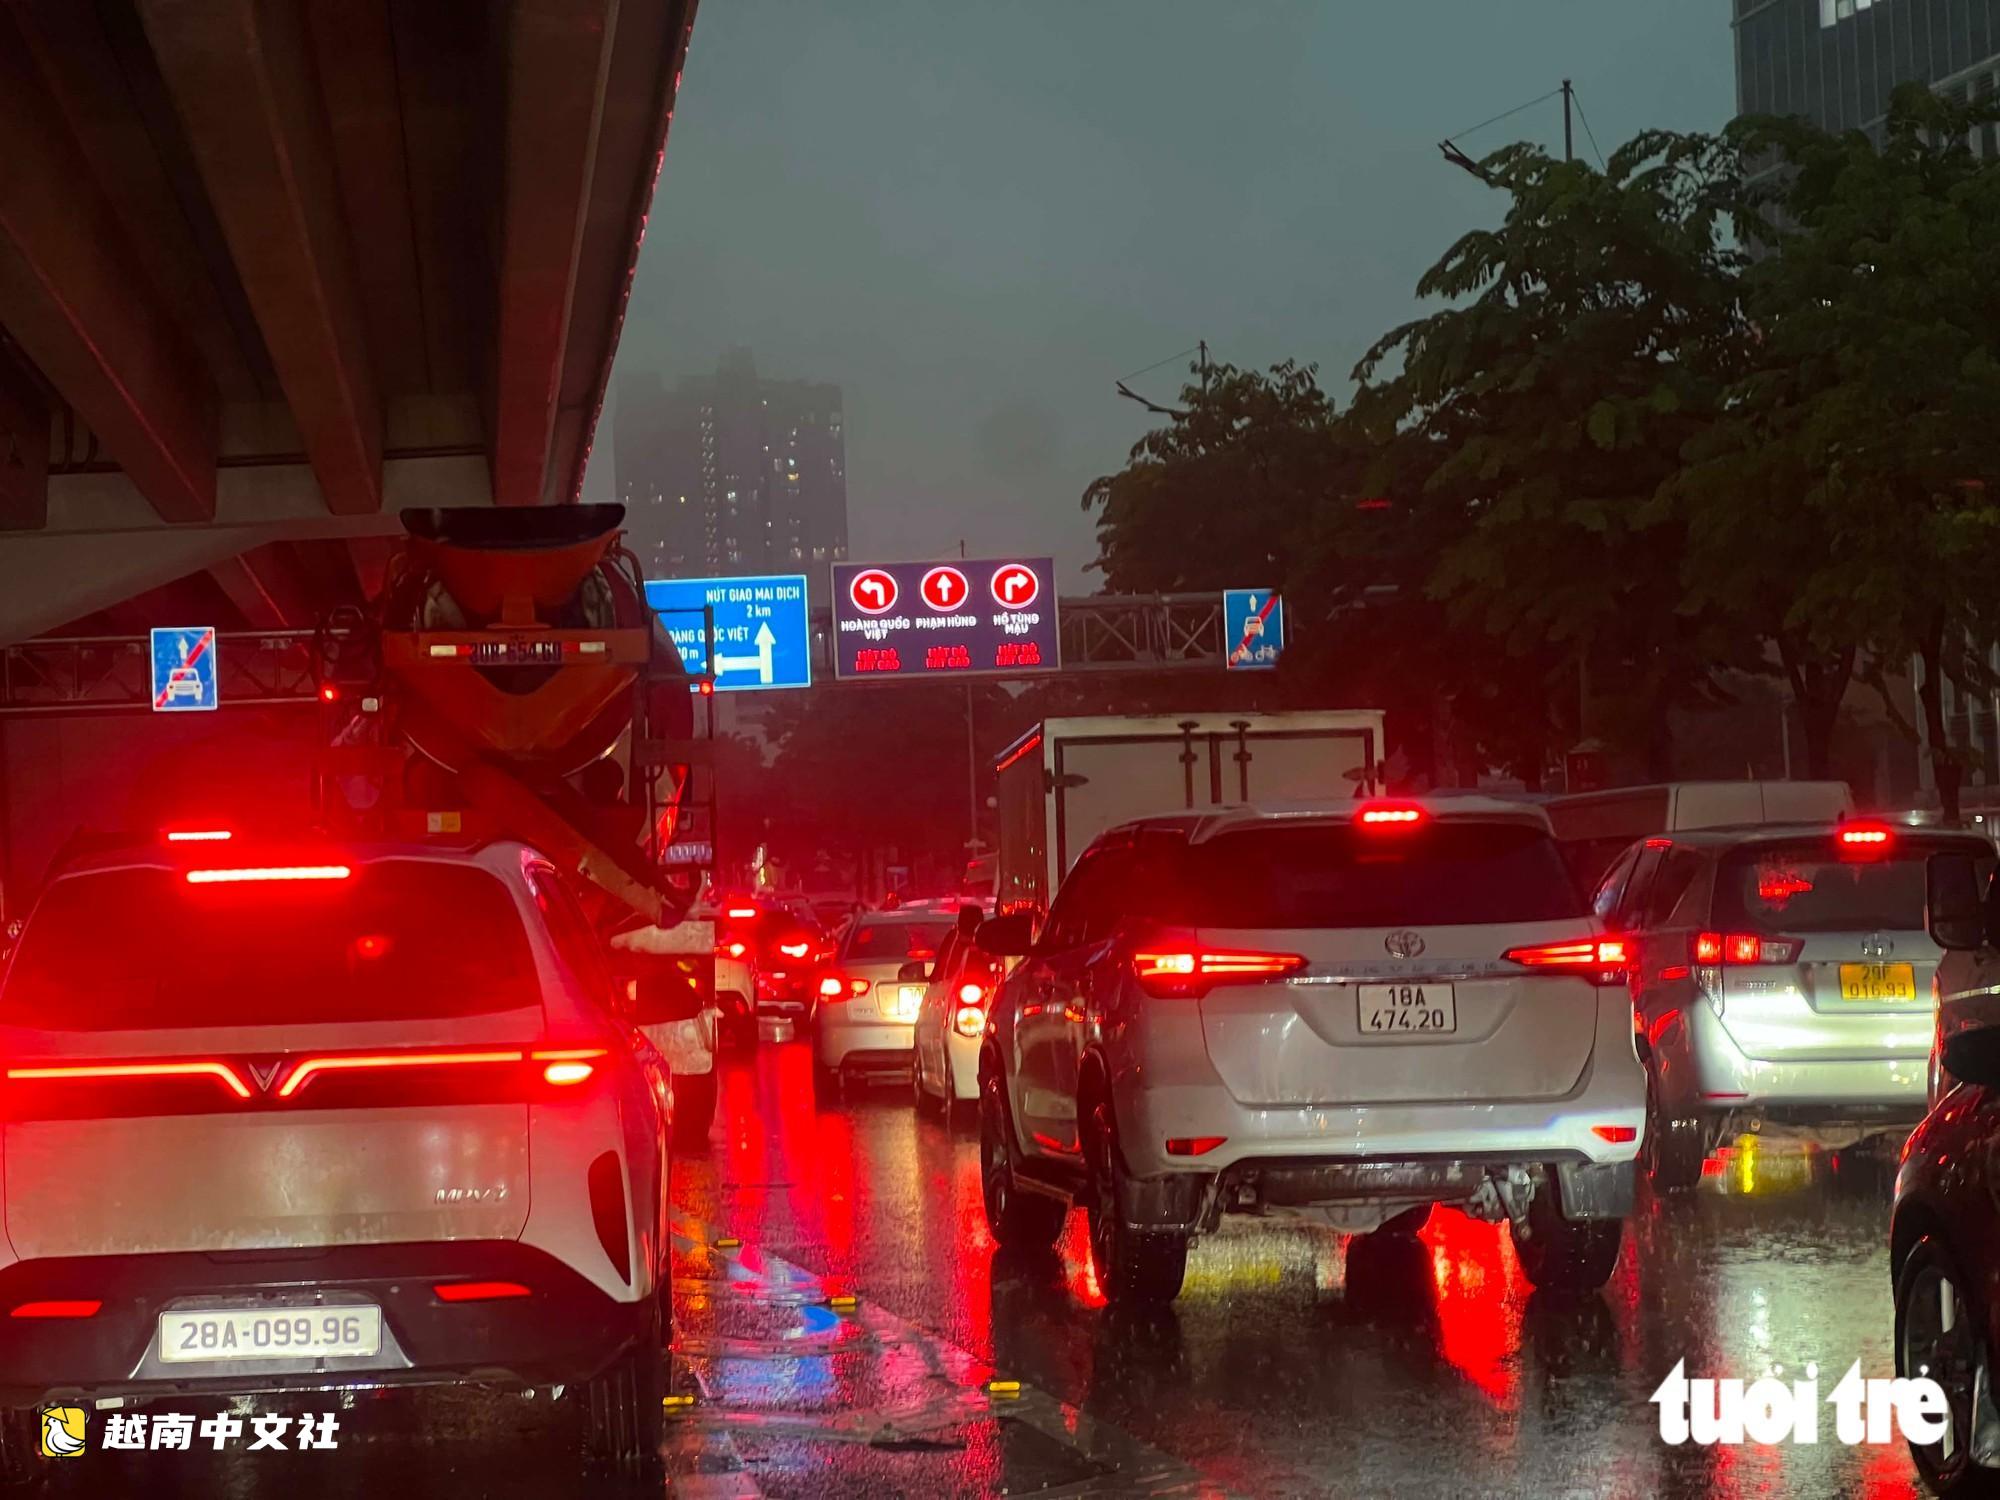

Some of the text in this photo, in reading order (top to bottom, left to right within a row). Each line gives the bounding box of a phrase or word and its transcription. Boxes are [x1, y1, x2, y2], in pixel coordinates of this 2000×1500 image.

[706, 586, 726, 603] NÚT
[729, 587, 753, 602] GIAO
[755, 586, 773, 601] MAI
[746, 604, 771, 618] 2 km
[727, 625, 749, 642] VIỆT
[689, 649, 699, 660] m
[1388, 986, 1426, 1006] 18A
[1370, 1009, 1445, 1030] 474.20
[180, 1317, 360, 1350] 28A-099.96
